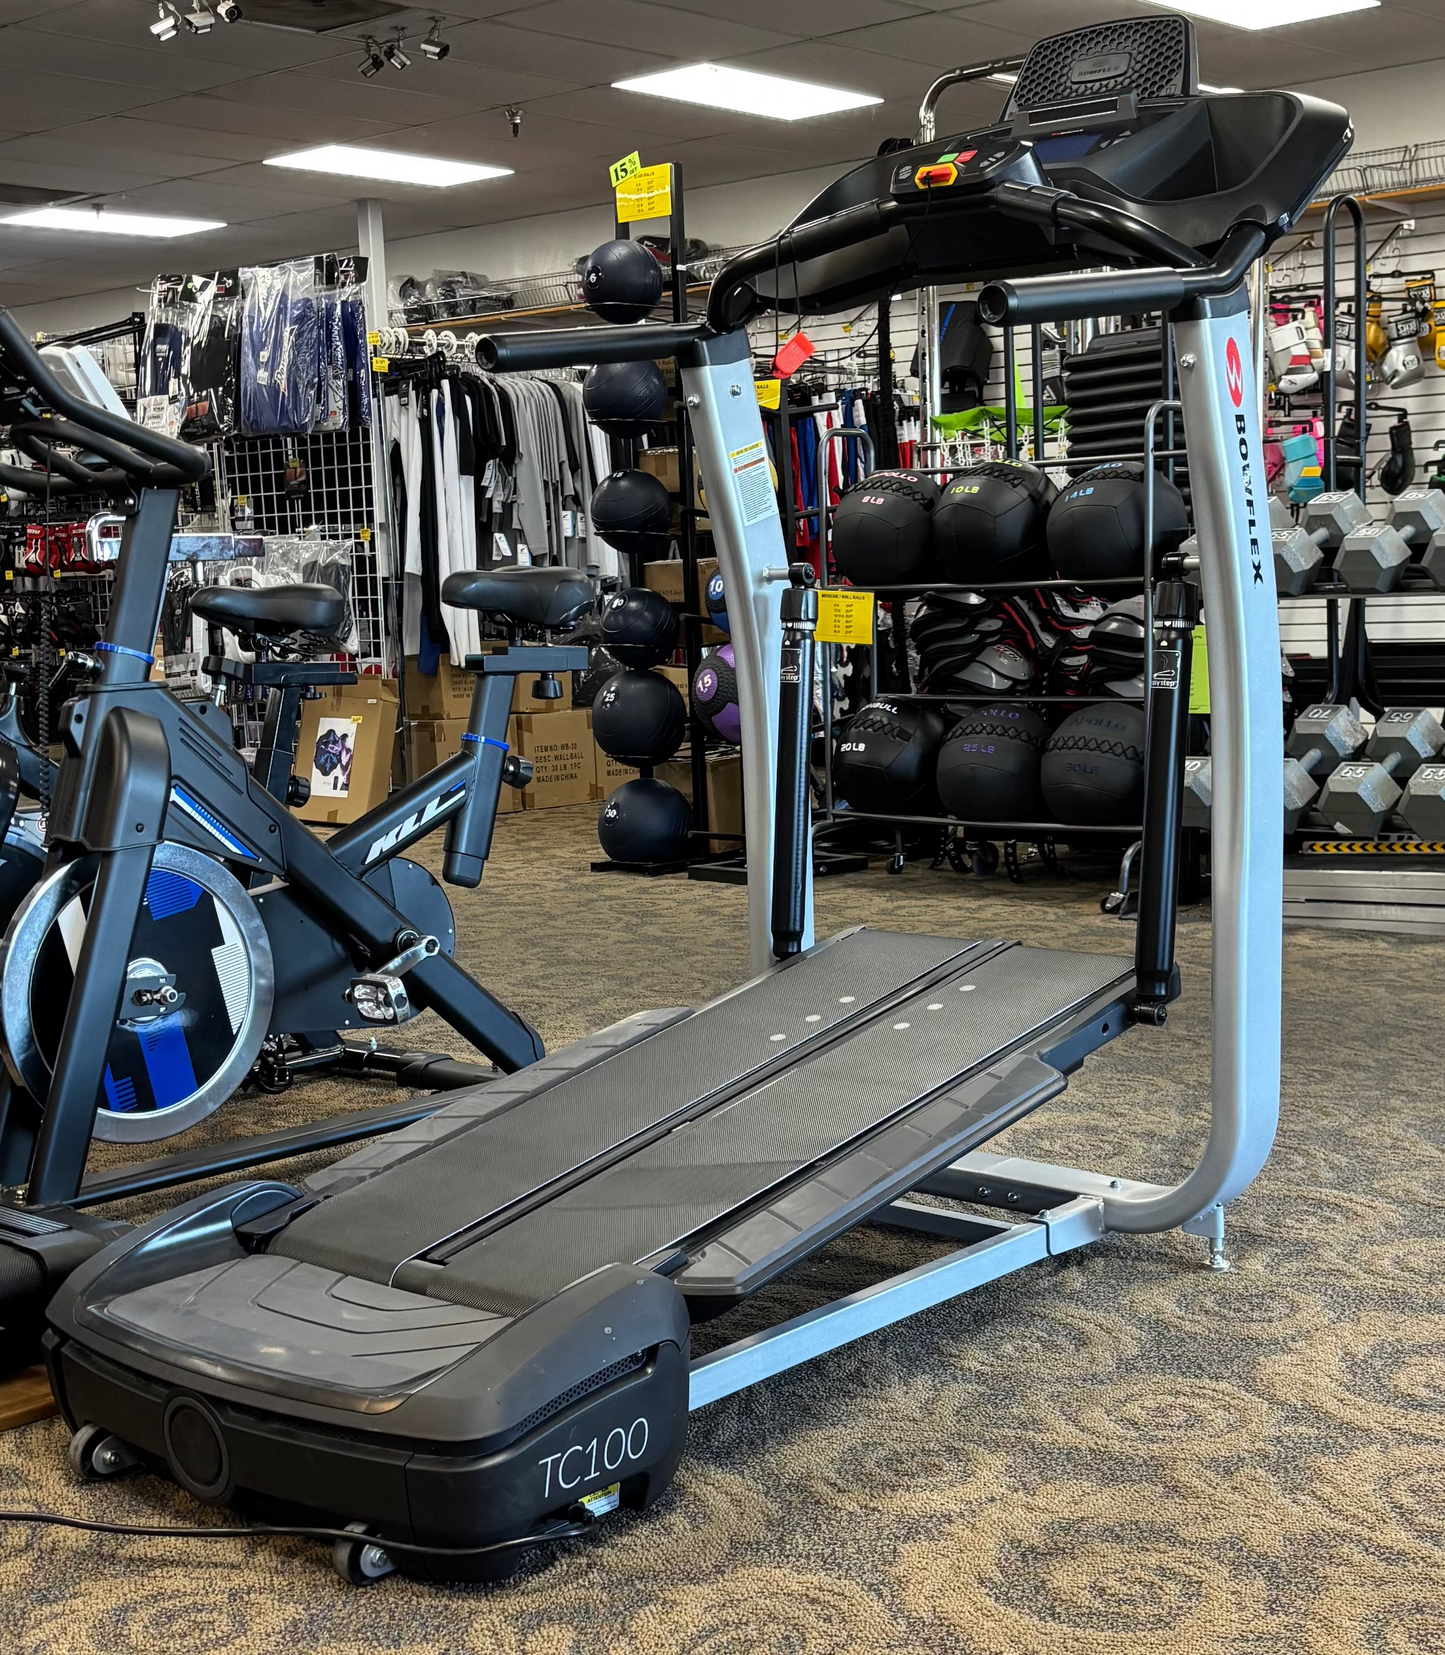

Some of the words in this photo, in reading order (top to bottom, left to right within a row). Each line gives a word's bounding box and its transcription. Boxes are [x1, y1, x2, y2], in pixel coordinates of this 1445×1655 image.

[590, 272, 597, 283] 6
[1235, 414, 1264, 585] BOWFLEX
[1356, 528, 1381, 537] 50
[710, 581, 724, 593] 10
[605, 693, 615, 702] 25
[1341, 766, 1367, 778] 65
[606, 809, 617, 818] 30
[365, 789, 466, 865] KLL
[538, 1417, 649, 1499] TC100
